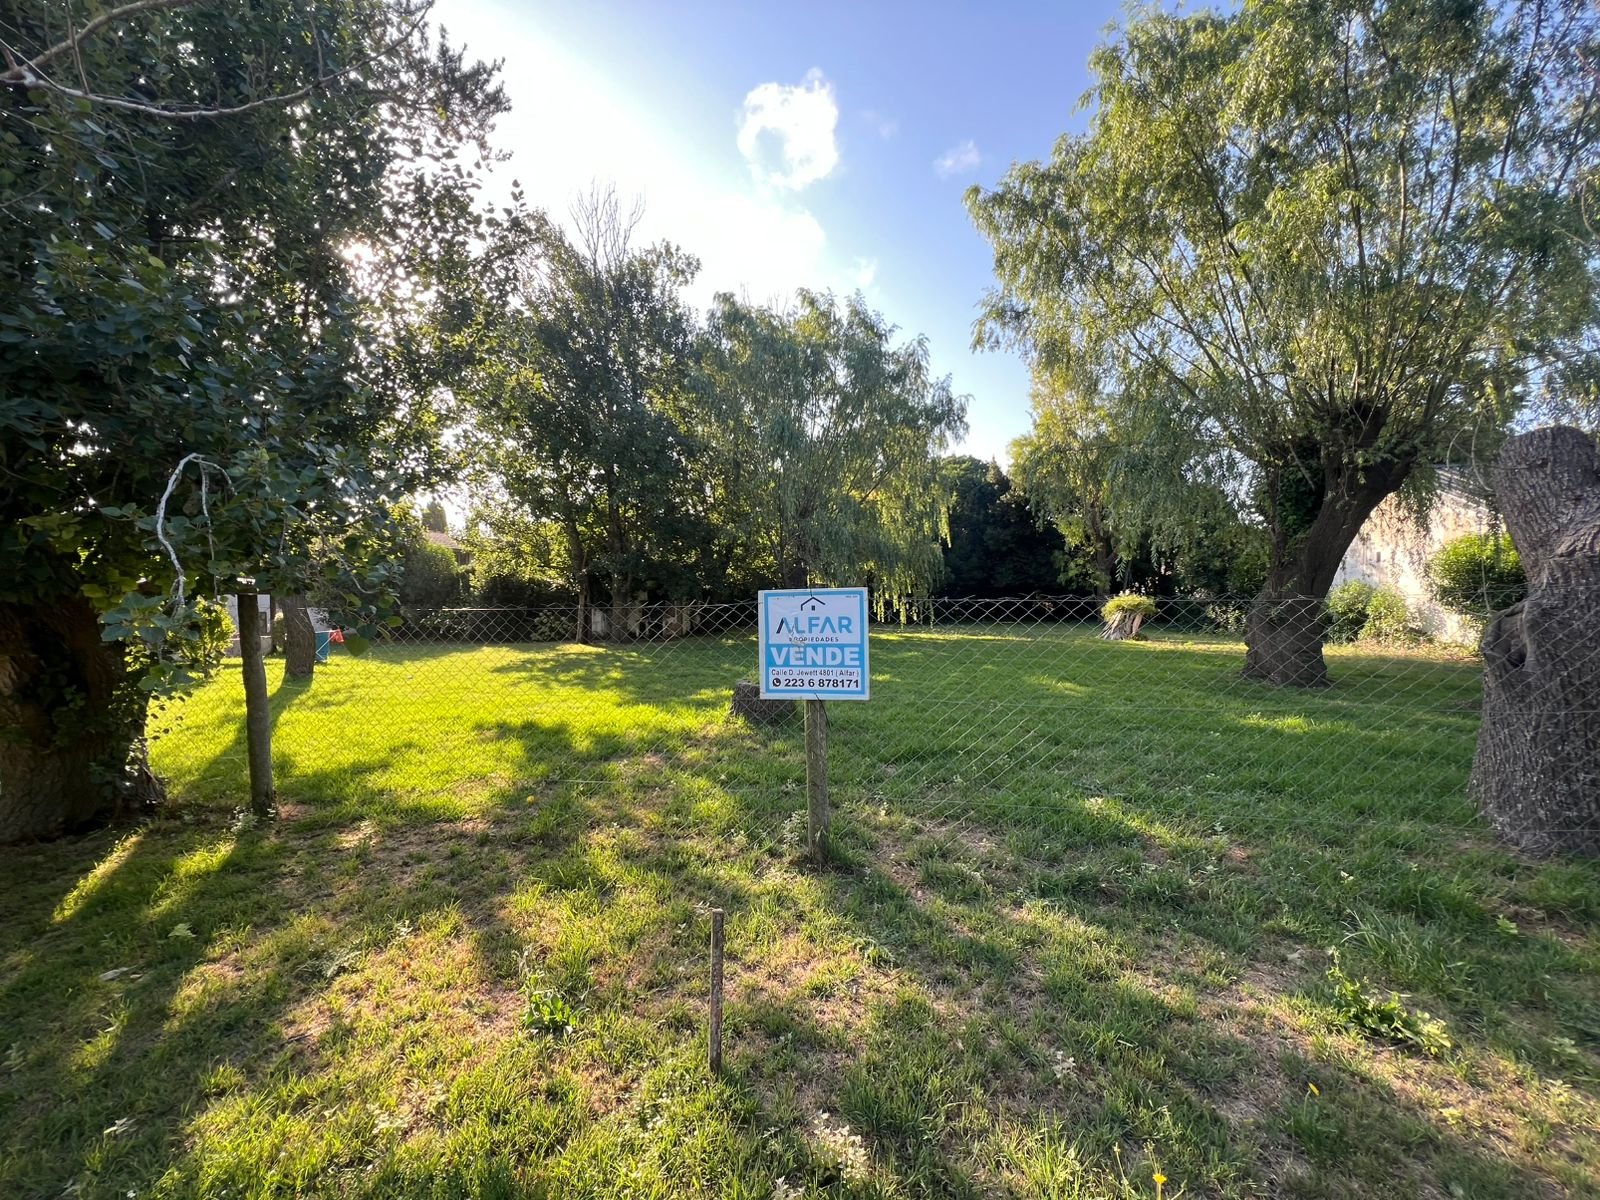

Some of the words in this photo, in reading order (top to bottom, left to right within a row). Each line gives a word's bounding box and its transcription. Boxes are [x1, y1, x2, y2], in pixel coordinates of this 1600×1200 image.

[776, 616, 852, 634] ALFAR
[770, 647, 860, 666] VENDE
[797, 669, 818, 677] Jewett
[784, 679, 805, 687] 223
[808, 679, 815, 688] 6
[818, 679, 859, 688] 878171
